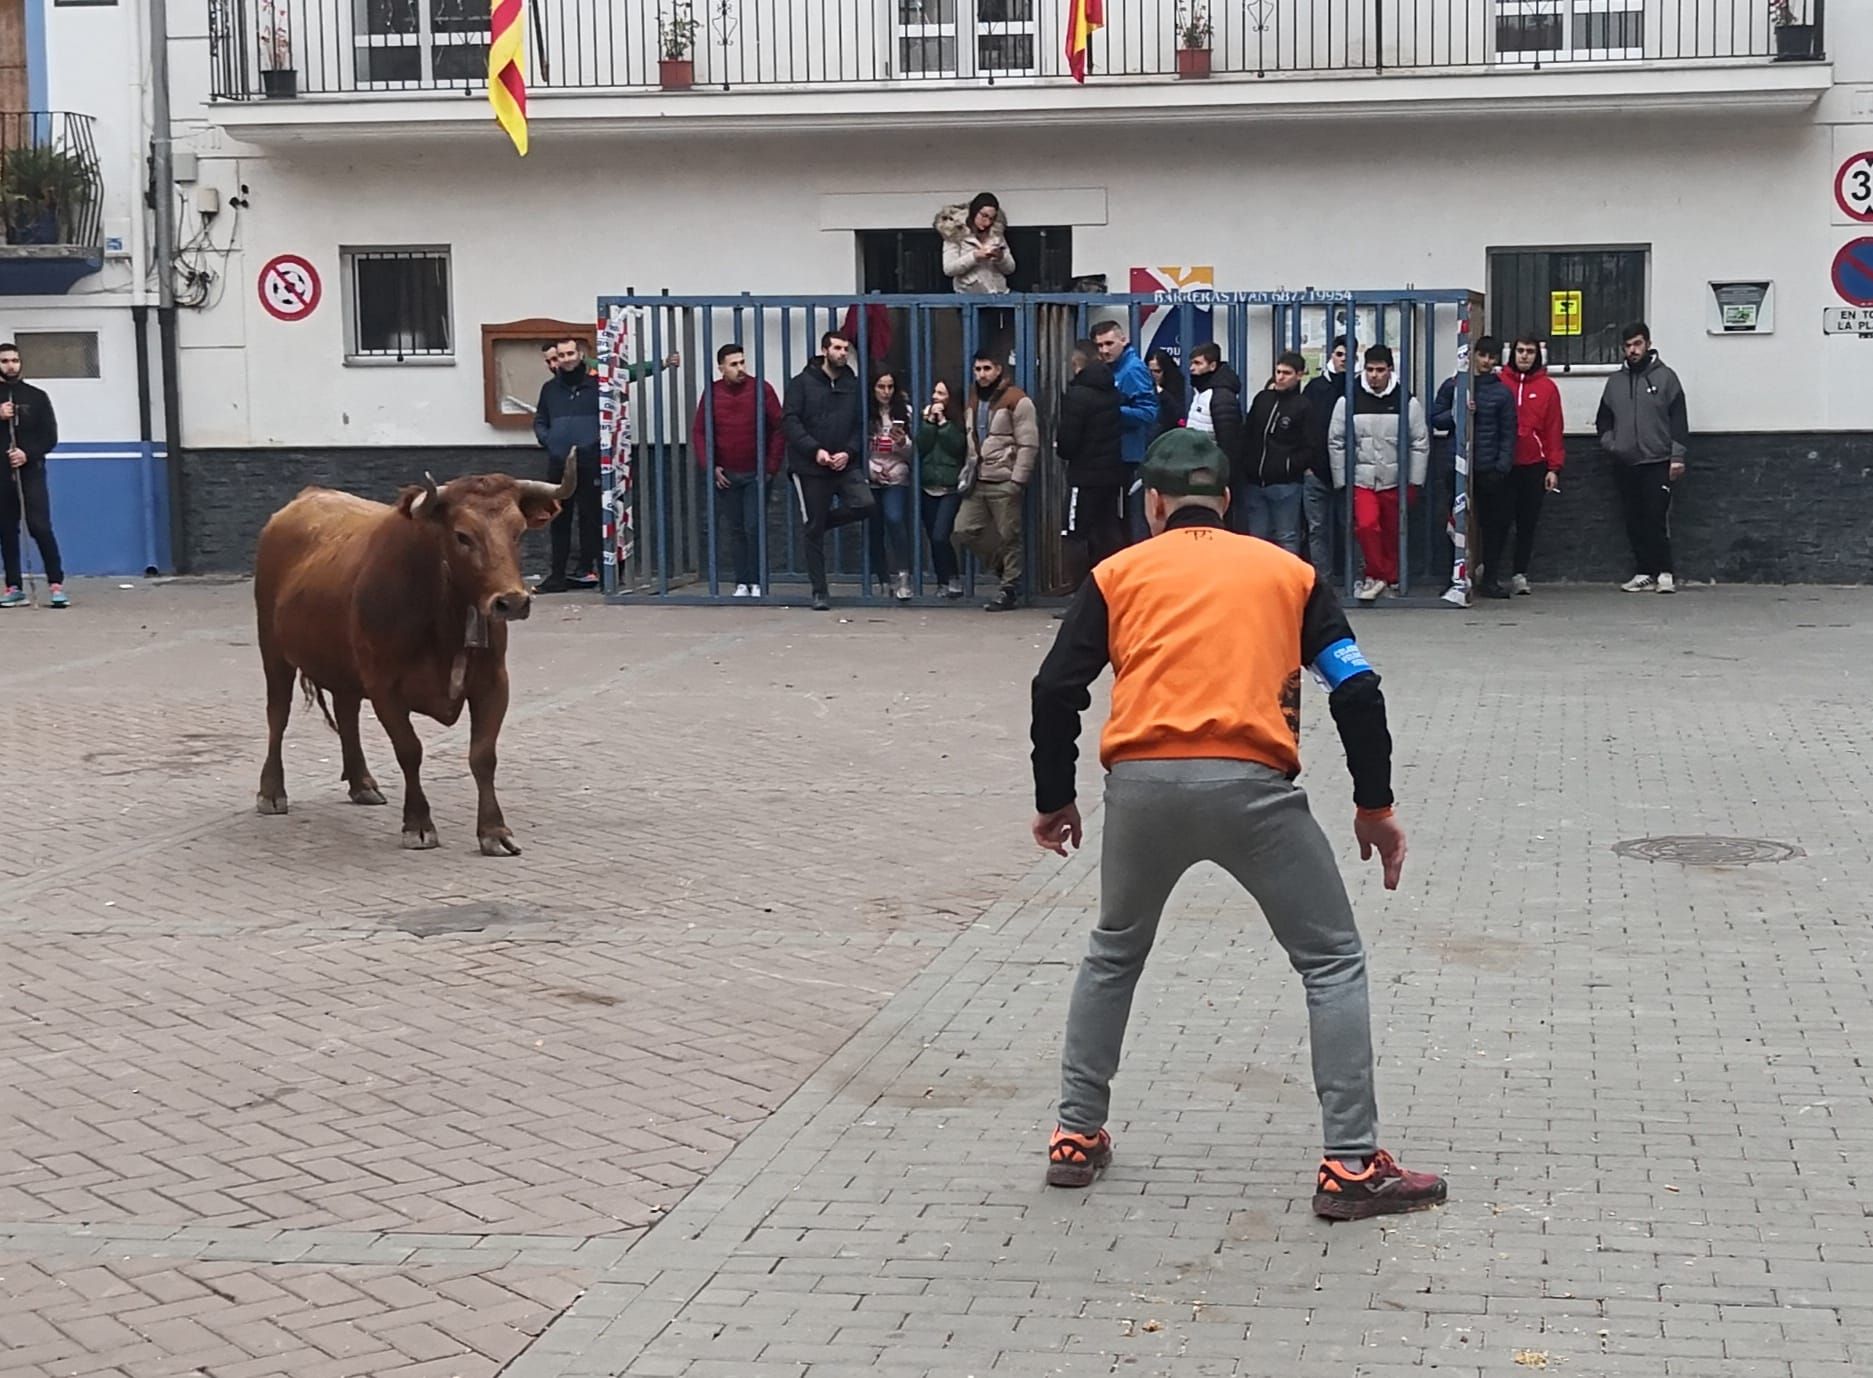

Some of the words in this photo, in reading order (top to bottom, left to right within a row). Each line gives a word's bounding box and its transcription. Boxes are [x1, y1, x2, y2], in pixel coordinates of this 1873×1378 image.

[1154, 291, 1230, 303] BARRERAS
[1840, 310, 1856, 320] EN
[1837, 321, 1852, 331] LA
[1858, 321, 1873, 331] PL
